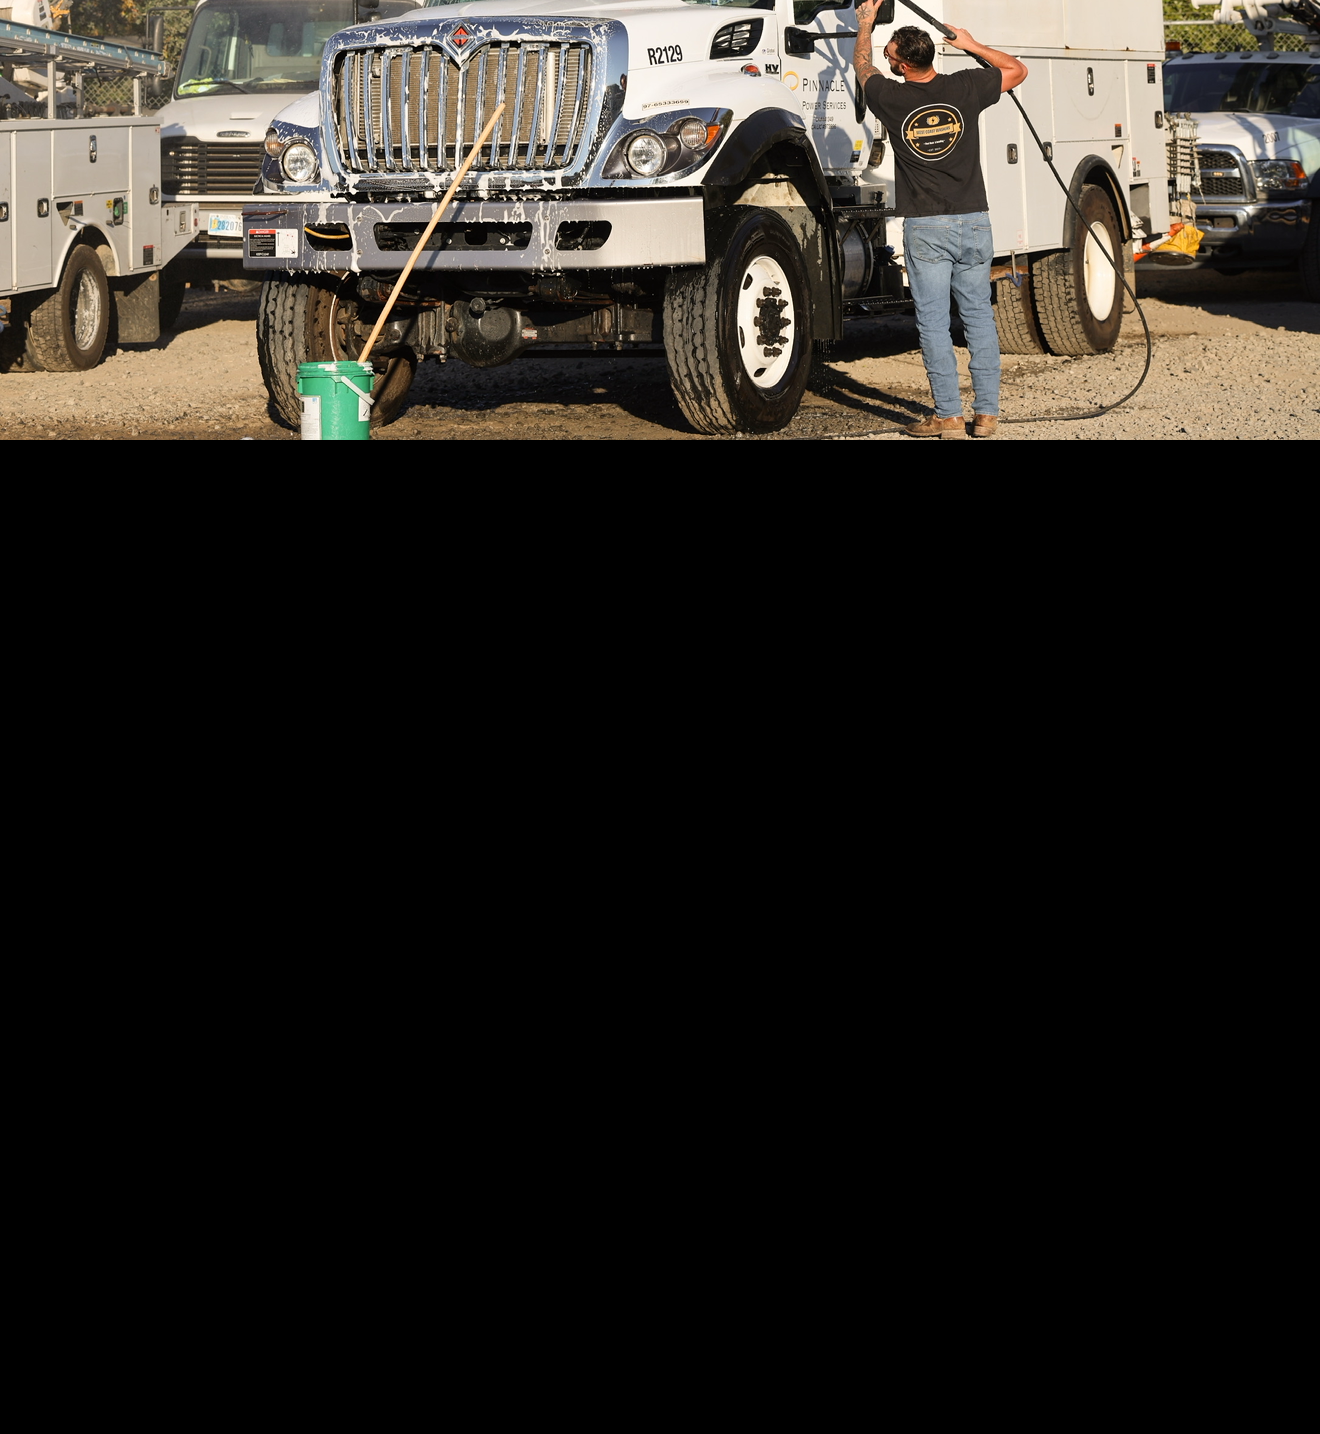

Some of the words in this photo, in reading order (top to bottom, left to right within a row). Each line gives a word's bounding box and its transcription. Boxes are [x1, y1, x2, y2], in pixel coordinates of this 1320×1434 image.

[647, 44, 683, 65] R2129
[765, 64, 779, 72] HV
[802, 78, 845, 92] PINNACLE
[802, 101, 821, 110] POWER
[822, 101, 847, 110] SERVICES
